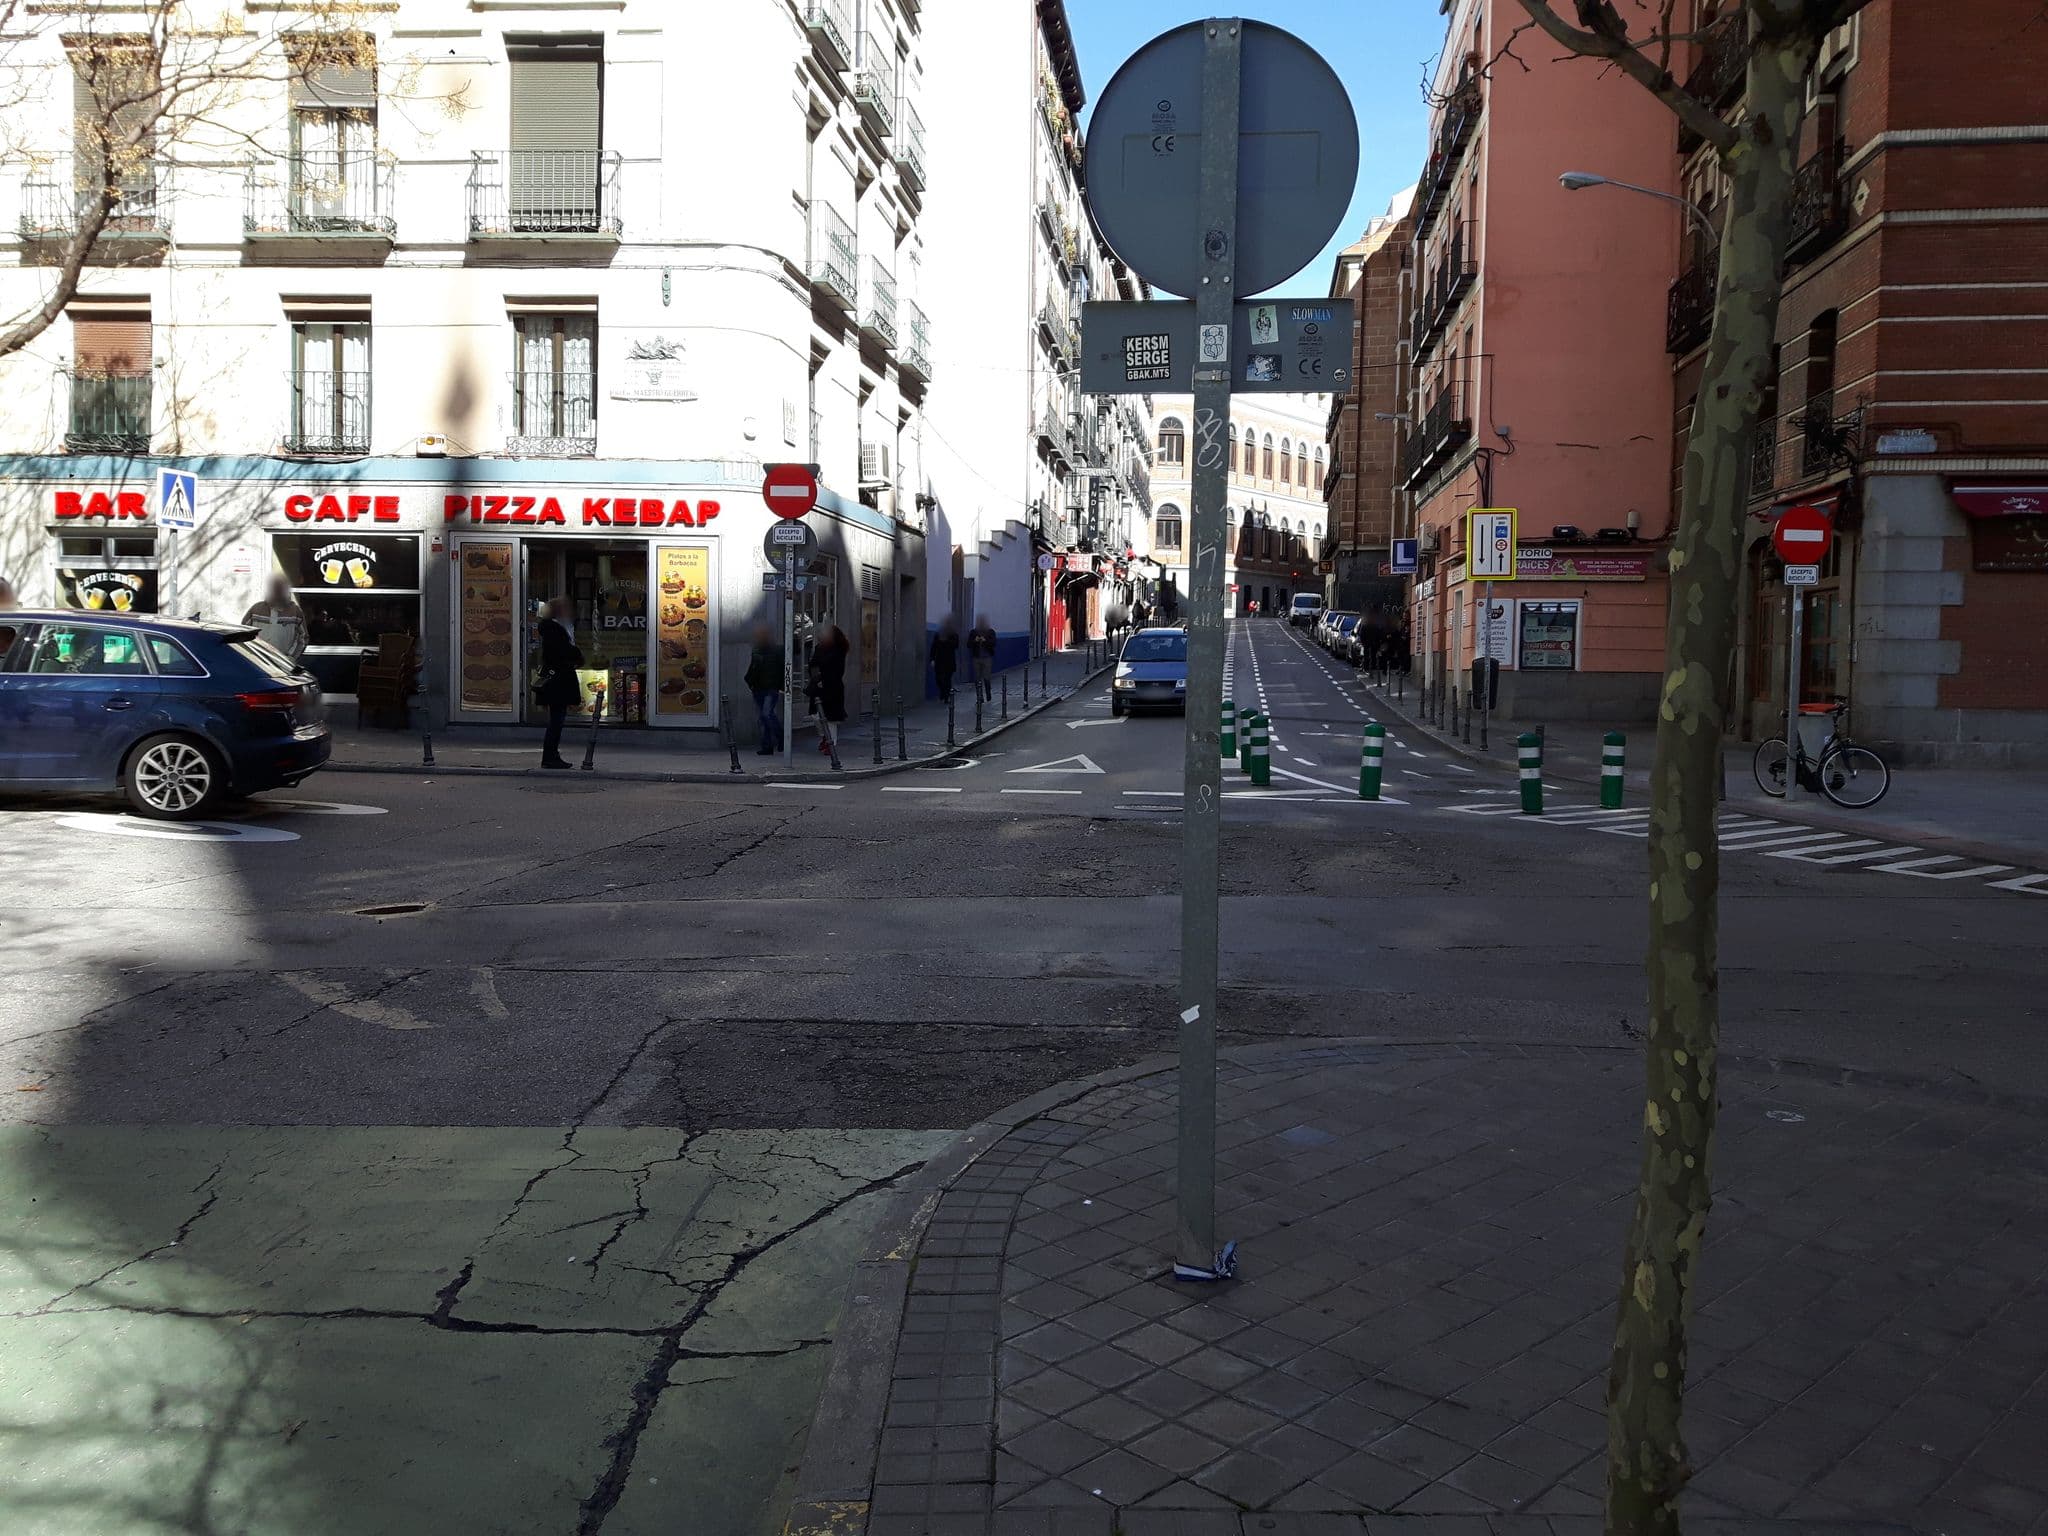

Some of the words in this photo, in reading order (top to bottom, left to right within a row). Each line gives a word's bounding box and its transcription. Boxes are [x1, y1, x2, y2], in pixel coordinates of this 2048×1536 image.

[1292, 307, 1332, 320] SLOWMAN
[1126, 335, 1169, 352] KERSM
[1126, 350, 1169, 367] SERGE
[1127, 368, 1170, 380] GBAK.MTS
[54, 491, 148, 520] BAR
[284, 494, 401, 523] CAFE
[444, 495, 566, 526] PIZZA
[582, 497, 721, 528] KEBAP
[313, 542, 377, 563] CERVECERIA
[1397, 543, 1414, 564] L
[1516, 549, 1552, 557] TORIO
[604, 615, 647, 628] BAR
